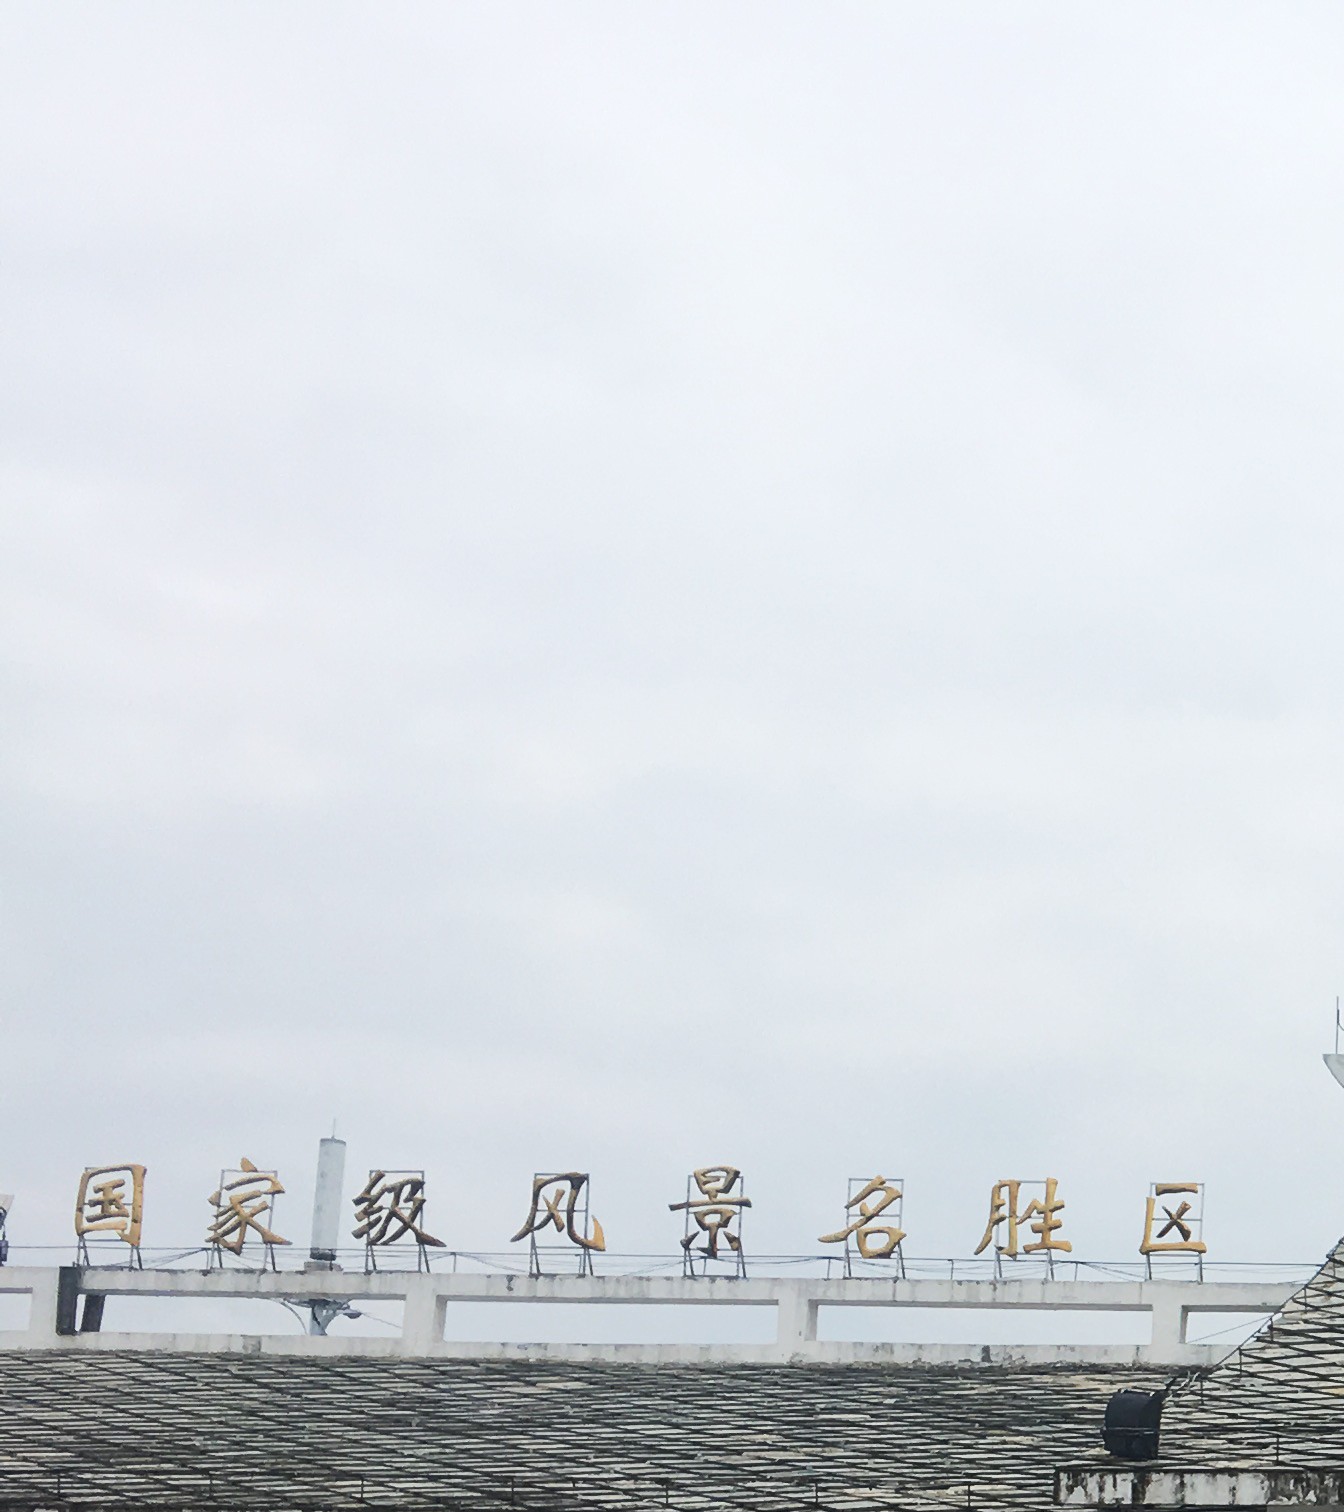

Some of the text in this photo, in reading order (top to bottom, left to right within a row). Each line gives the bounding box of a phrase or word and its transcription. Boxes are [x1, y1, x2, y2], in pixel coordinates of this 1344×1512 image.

[75, 1157, 1207, 1260] 国家级风景名胜区
